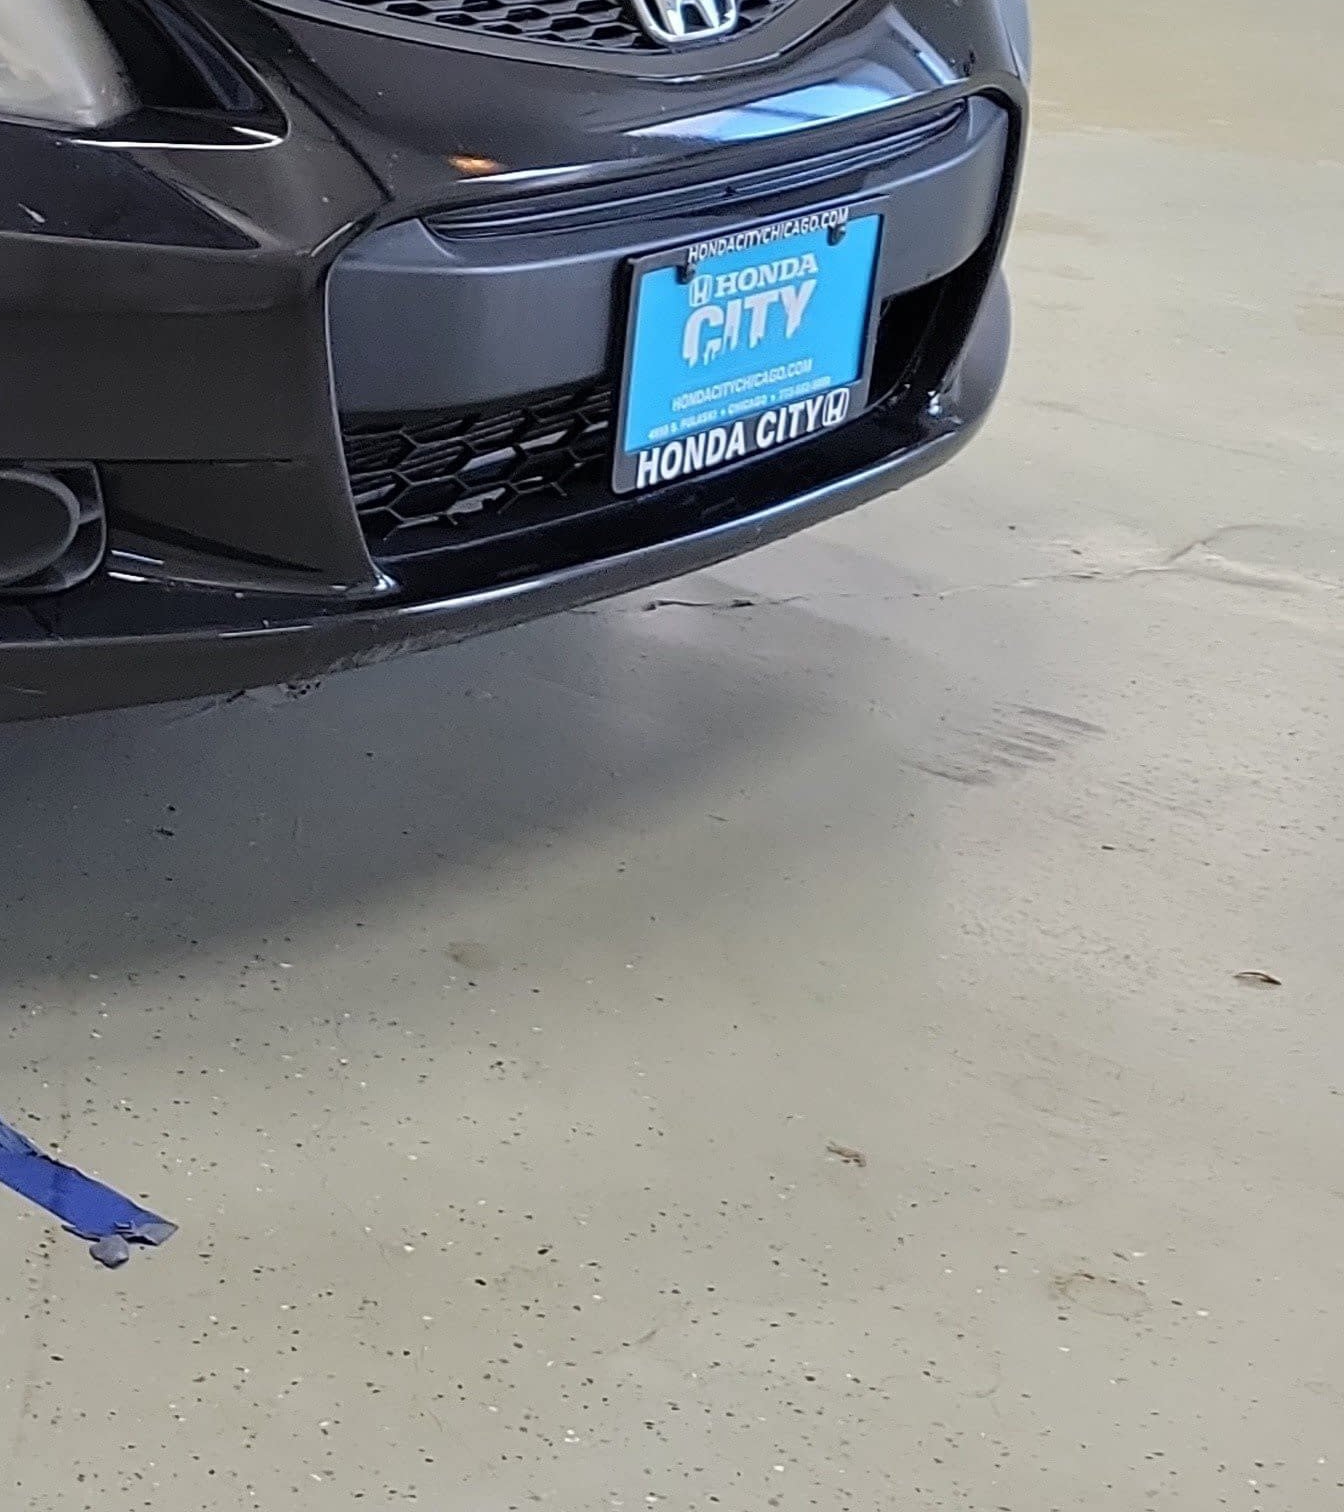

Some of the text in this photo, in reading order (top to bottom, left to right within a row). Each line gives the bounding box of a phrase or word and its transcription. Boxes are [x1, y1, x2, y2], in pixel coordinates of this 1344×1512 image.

[686, 206, 850, 264] HONDACITYCHICAGO.COM
[714, 252, 819, 298] HONDA
[682, 278, 818, 368] CITY
[671, 357, 813, 412] HONDACITYCHICAGO.COM
[635, 394, 826, 489] HONDA CITY
